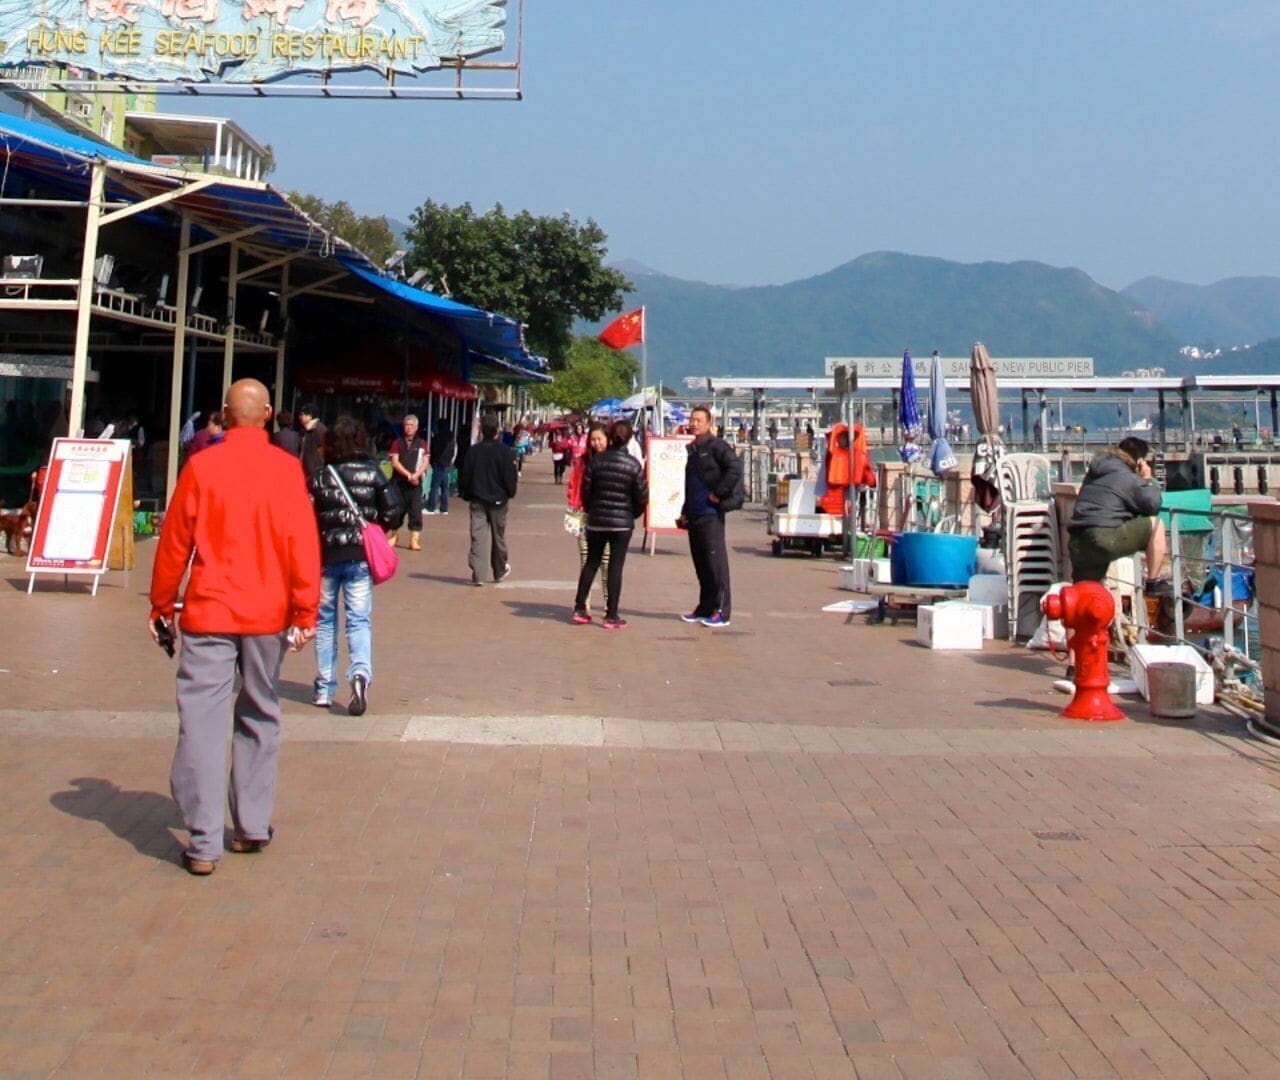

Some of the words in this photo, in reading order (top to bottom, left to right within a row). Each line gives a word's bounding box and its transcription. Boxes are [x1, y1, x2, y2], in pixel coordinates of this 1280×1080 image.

[27, 29, 88, 54] HUNG
[100, 30, 141, 55] KEE
[155, 31, 260, 58] SEAFOOD
[272, 32, 424, 60] RESTAURANT
[1002, 361, 1025, 373] NEW
[1028, 361, 1065, 373] PUBLIC
[1067, 361, 1090, 373] PIER
